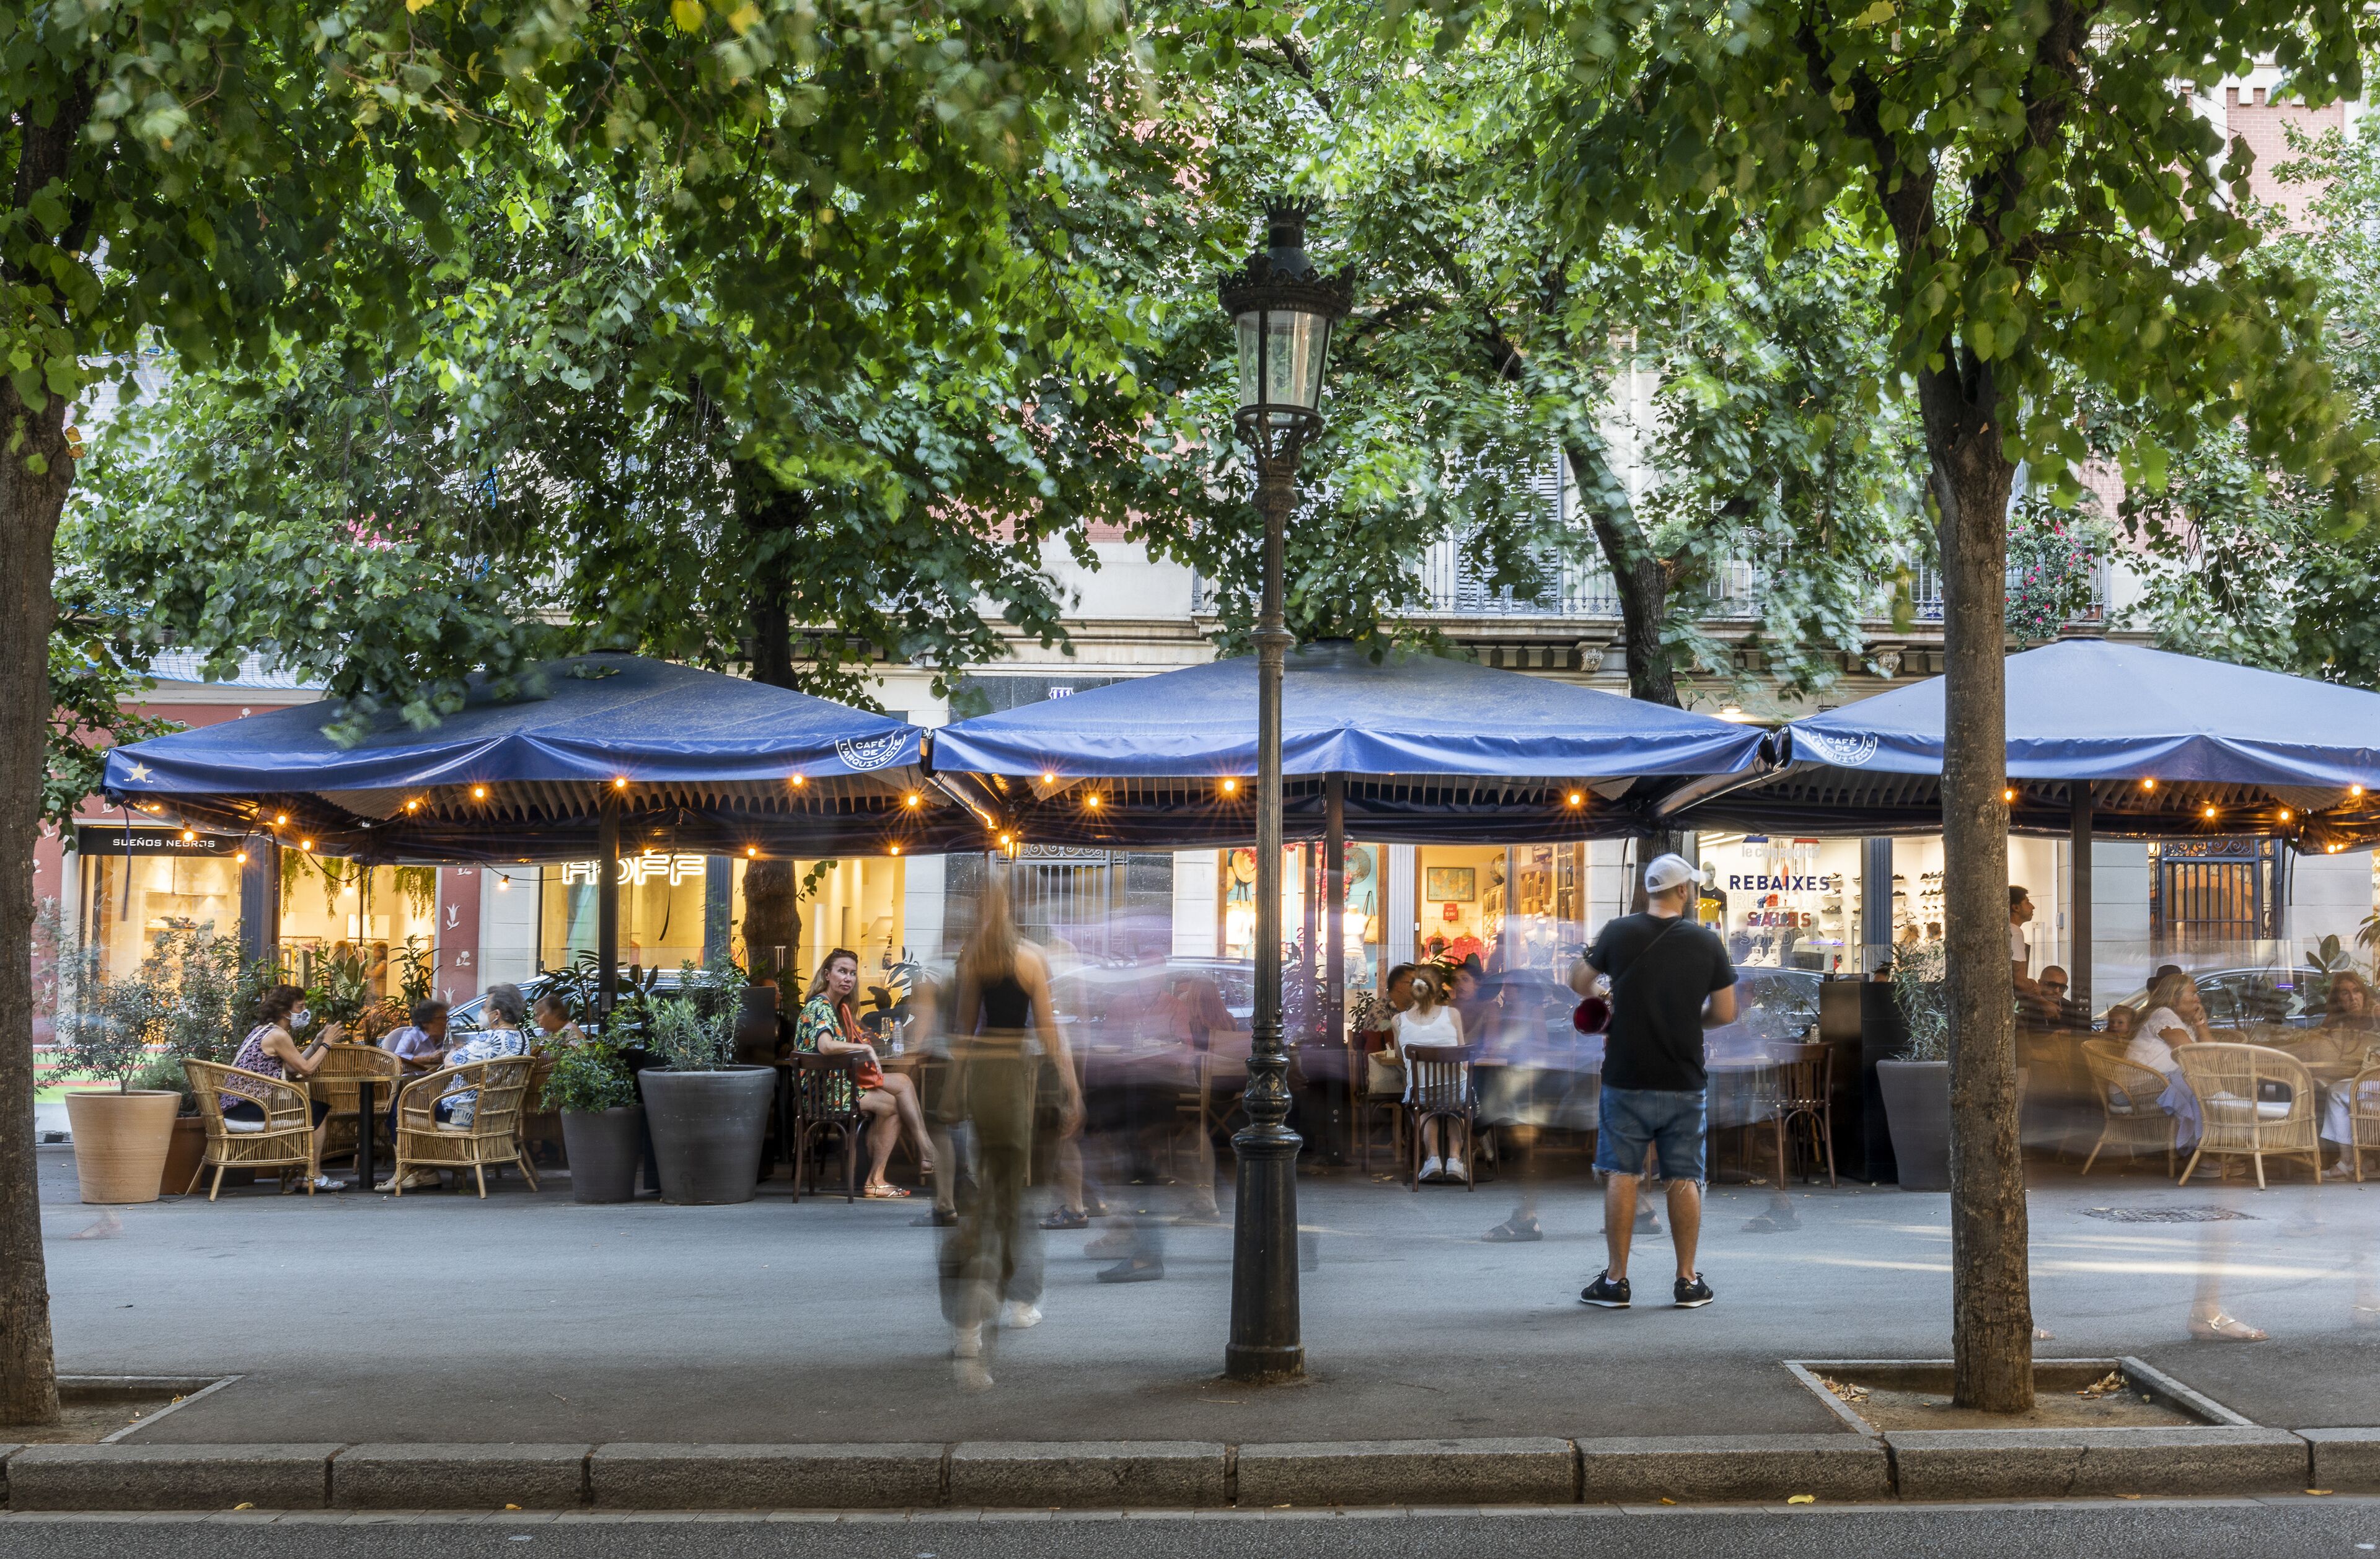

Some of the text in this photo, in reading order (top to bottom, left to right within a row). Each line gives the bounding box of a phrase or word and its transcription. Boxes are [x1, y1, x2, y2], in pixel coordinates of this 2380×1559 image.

[855, 739, 886, 749] CAFÈ
[840, 739, 902, 767] L'ARQUITECTE
[113, 837, 162, 847] SUEÑOS
[1729, 875, 1830, 891] REBAIXES
[1733, 893, 1827, 909] REAS
[1747, 911, 1812, 928] SALES
